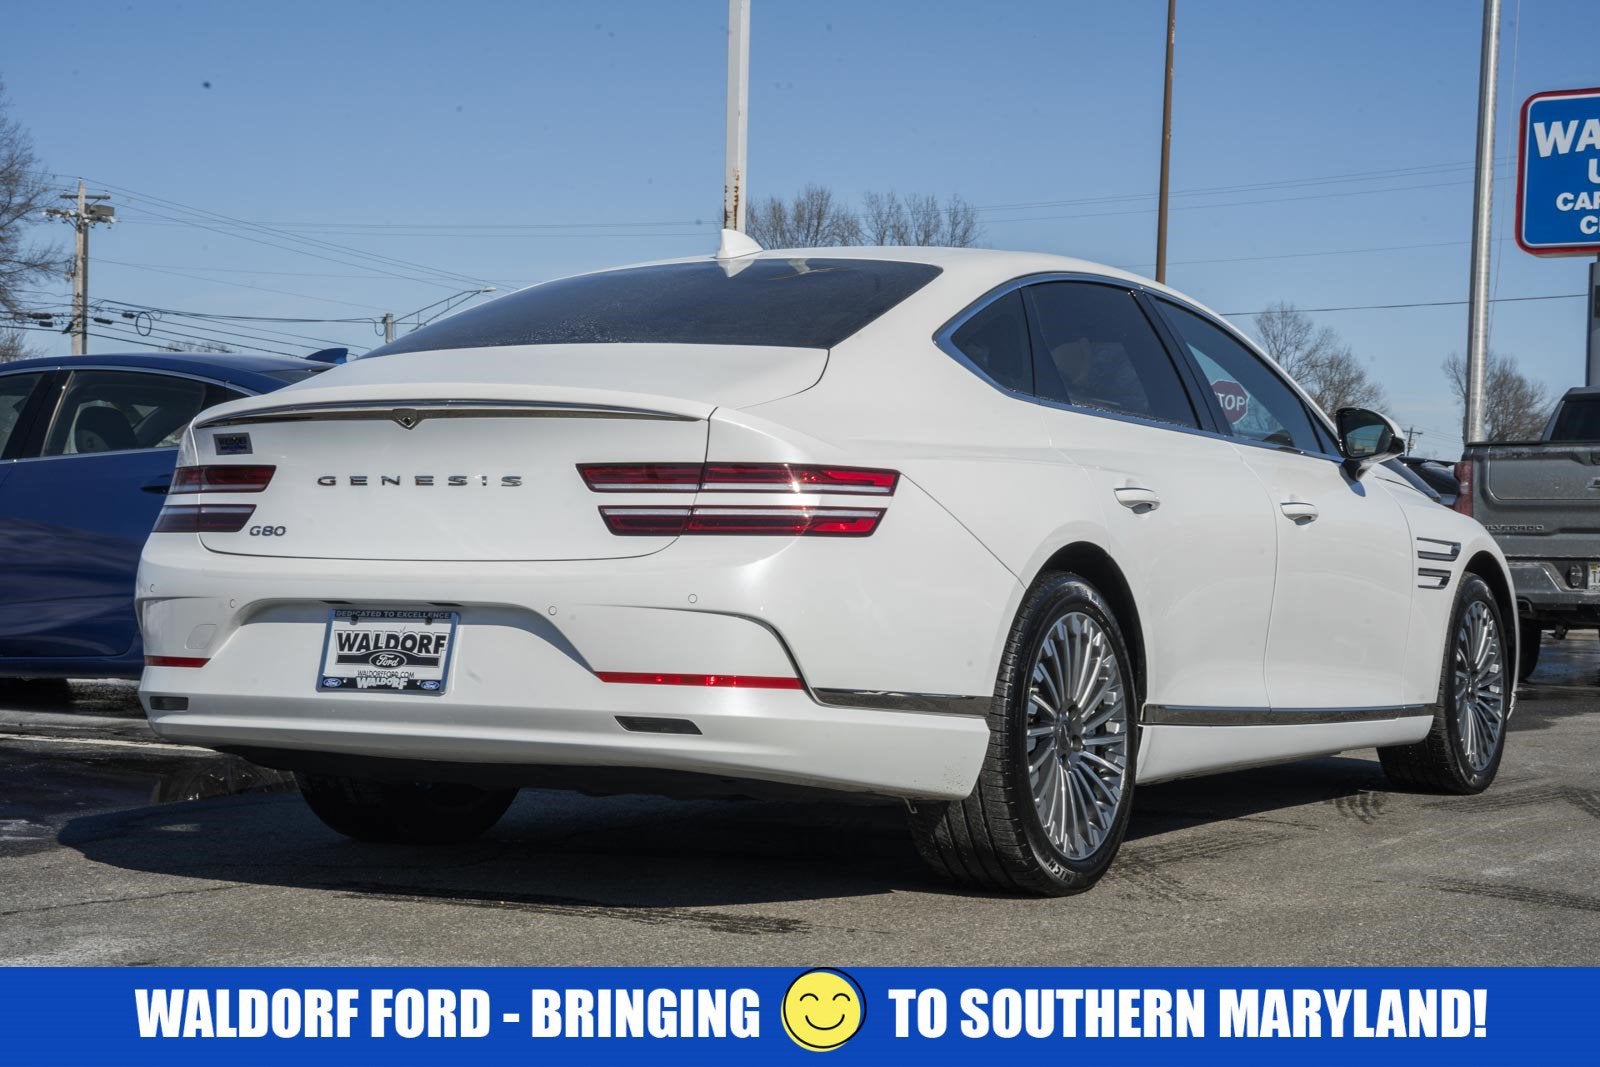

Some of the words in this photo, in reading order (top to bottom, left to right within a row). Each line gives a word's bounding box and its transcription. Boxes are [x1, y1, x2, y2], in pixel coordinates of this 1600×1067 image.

[1215, 391, 1245, 411] TOP
[317, 475, 523, 487] GENESIS
[249, 525, 287, 537] G80
[396, 611, 449, 619] EXCELLENCE
[336, 631, 448, 655] WALDORF
[376, 653, 400, 667] Ford
[356, 676, 409, 690] WALDORF
